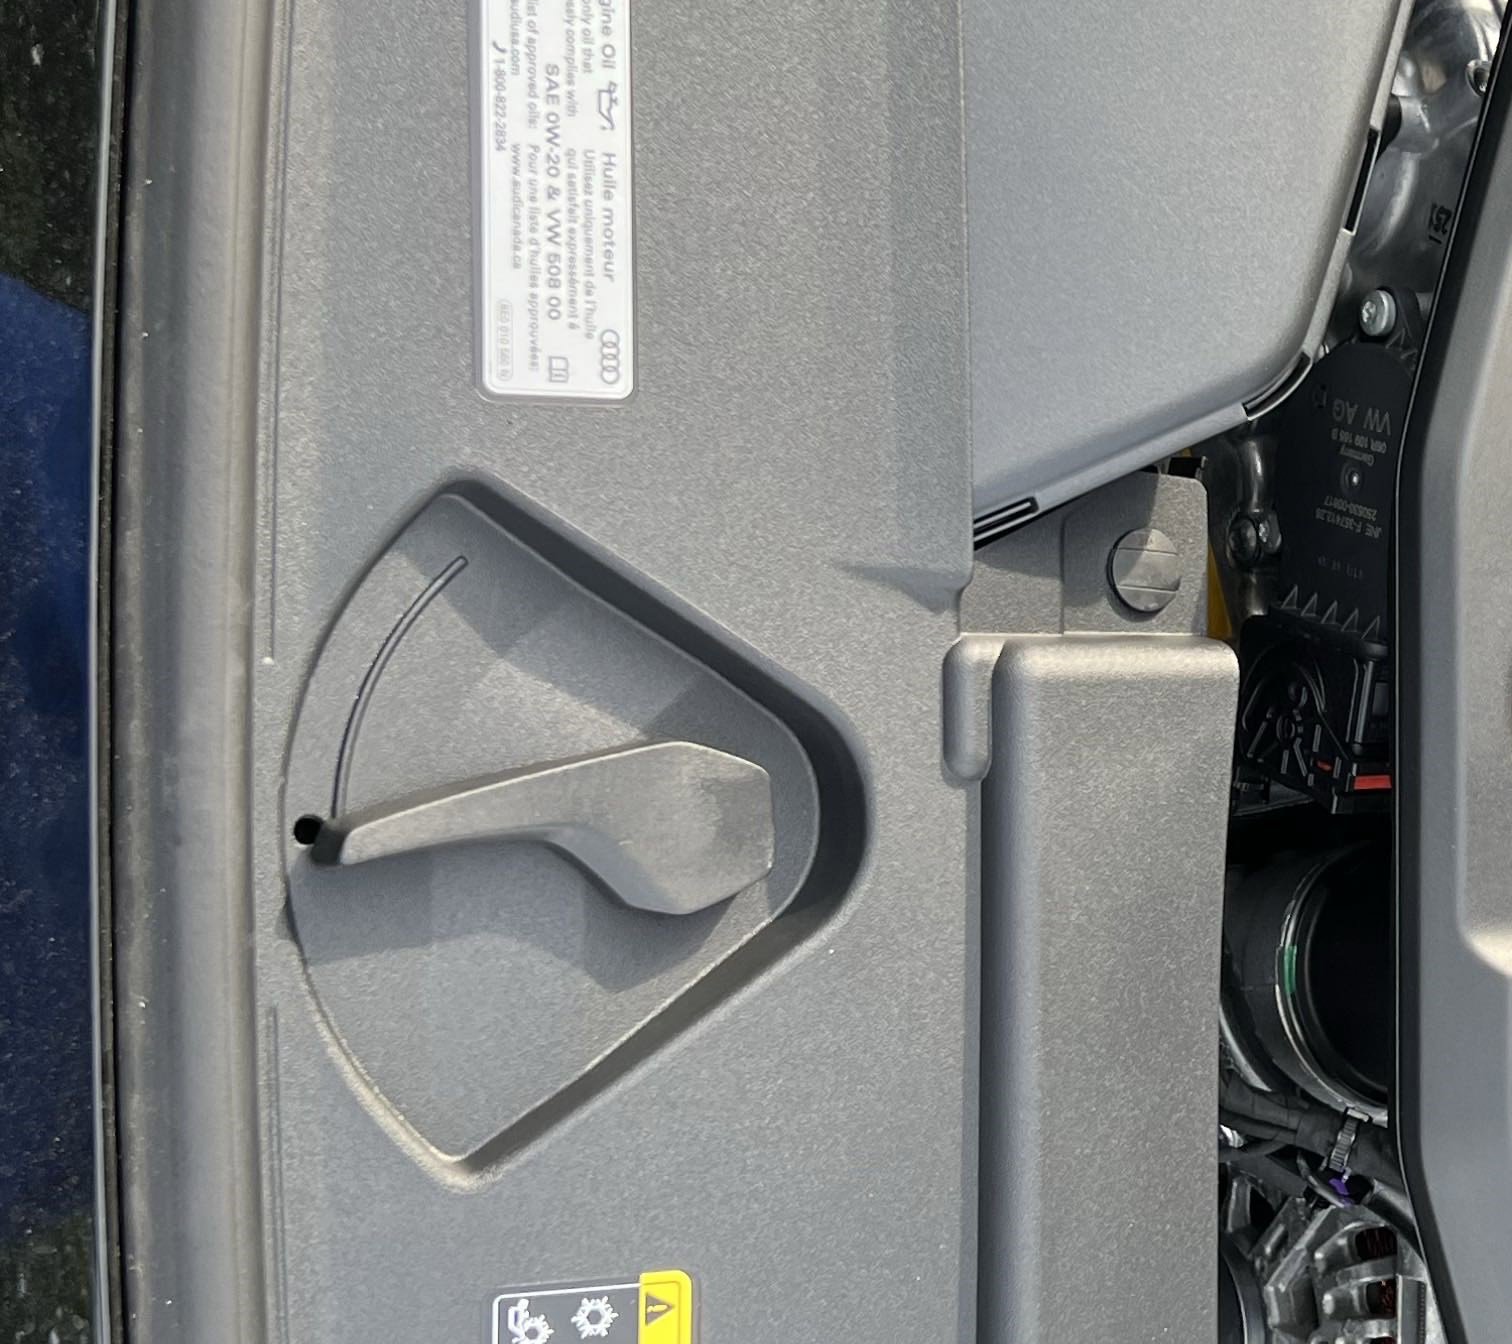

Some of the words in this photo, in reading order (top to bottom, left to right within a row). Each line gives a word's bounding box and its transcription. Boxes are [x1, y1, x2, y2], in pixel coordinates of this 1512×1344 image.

[527, 20, 539, 34] of
[583, 28, 593, 45] oil
[524, 37, 539, 98] approved
[562, 29, 577, 86] complies
[583, 48, 593, 74] that
[601, 44, 616, 69] Oil
[545, 63, 560, 105] SAE
[494, 58, 507, 152] 1-800-822-2834
[528, 102, 539, 129] oils:
[567, 90, 577, 117] with
[527, 144, 540, 175] Pour
[545, 112, 560, 178] 0W-20
[564, 148, 578, 169] qui
[583, 149, 595, 197] Utilisez
[602, 152, 617, 201] Huile
[528, 179, 539, 202] une
[547, 185, 561, 201] &
[567, 173, 579, 223] satisfait
[511, 144, 523, 270] www.audicanada.ca
[528, 206, 541, 234] liste
[547, 210, 561, 247] VW
[582, 199, 596, 277] uniquement
[602, 208, 617, 282] moteur
[547, 253, 561, 289] 508
[565, 228, 580, 318] expressément
[584, 280, 596, 297] de
[548, 296, 561, 321] 00
[1332, 399, 1358, 425] AG
[1363, 408, 1391, 436] VW
